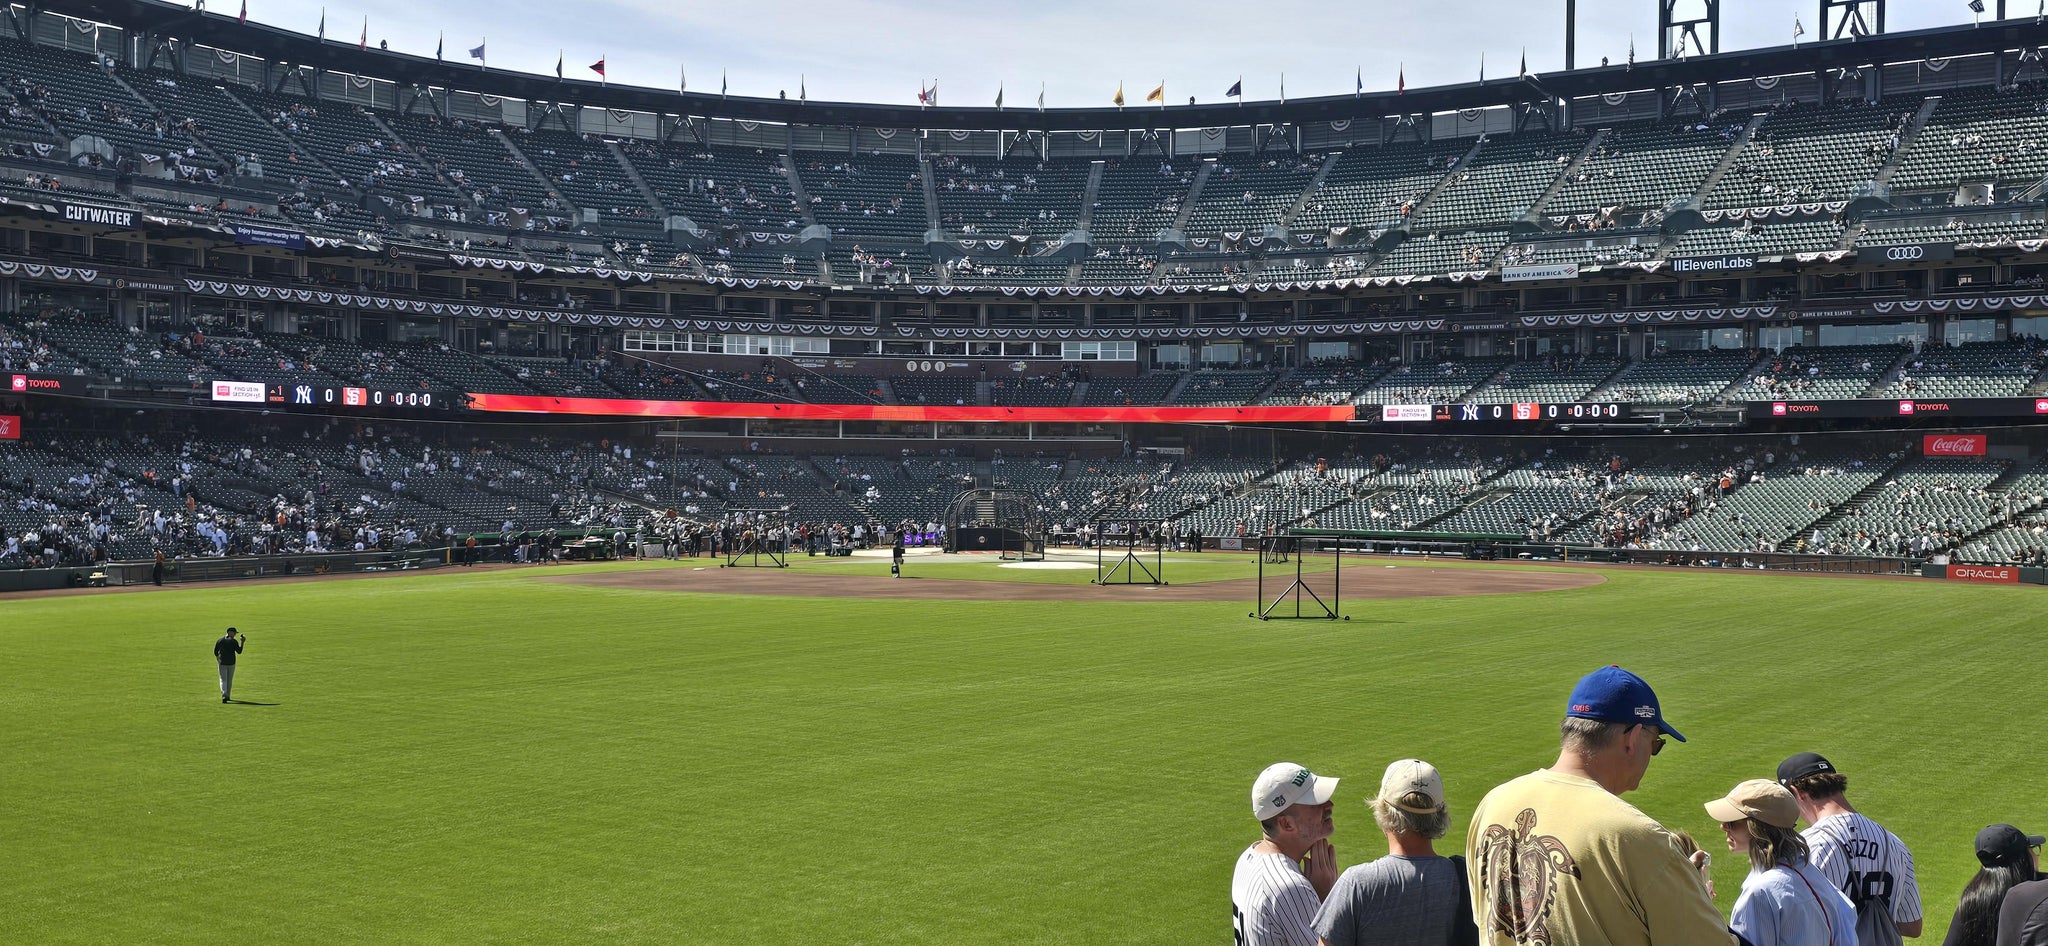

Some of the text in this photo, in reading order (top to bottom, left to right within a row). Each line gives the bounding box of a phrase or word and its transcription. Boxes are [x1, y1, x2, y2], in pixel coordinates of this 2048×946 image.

[66, 205, 131, 226] CUTWATER
[28, 379, 60, 388] TOYOTA
[278, 385, 282, 396] 1
[325, 388, 333, 402] 0
[374, 391, 382, 405] 0
[395, 392, 403, 405] 0
[410, 392, 417, 406] 0
[423, 393, 431, 406] 0
[1444, 405, 1449, 415] 1
[1493, 405, 1502, 418] 0
[1548, 405, 1557, 418] 0
[1574, 404, 1583, 417] 0
[1591, 404, 1600, 417] 0
[1609, 404, 1618, 417] 0
[1955, 569, 2009, 579] ORACLE
[1572, 704, 1590, 712] CUBS
